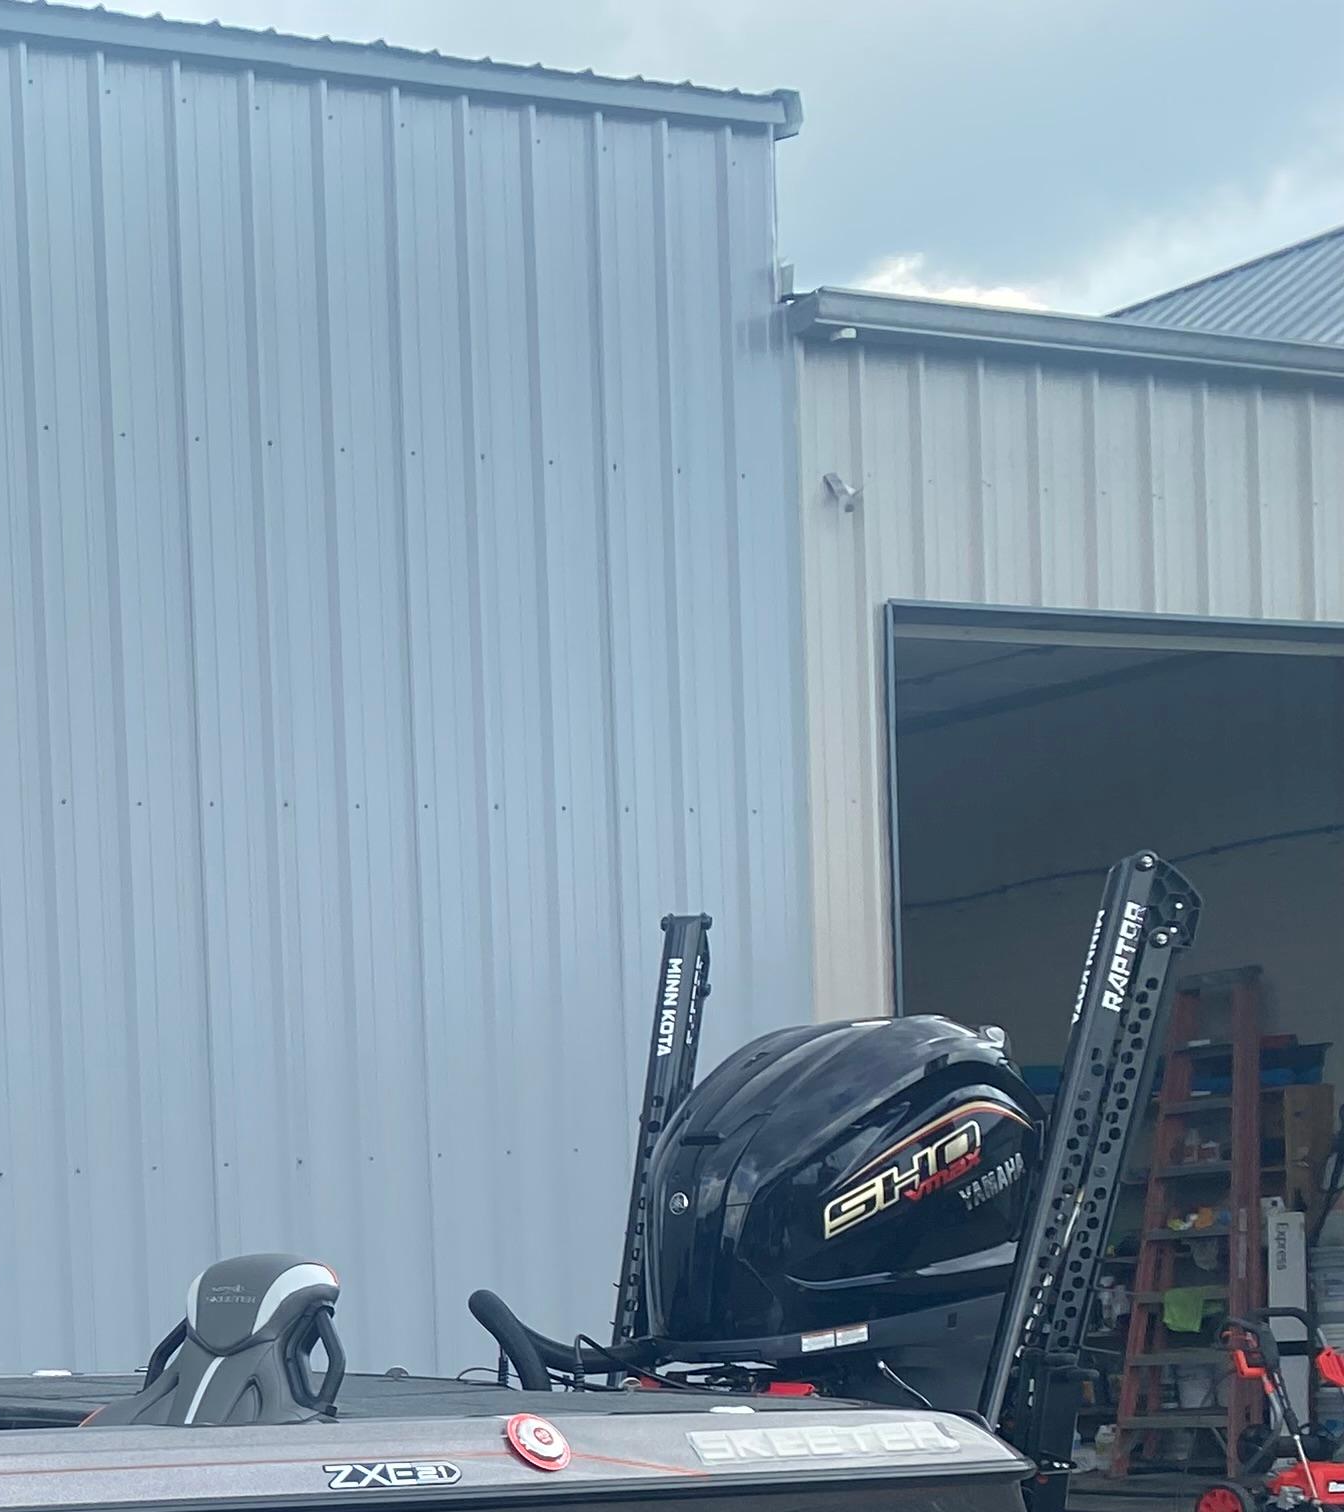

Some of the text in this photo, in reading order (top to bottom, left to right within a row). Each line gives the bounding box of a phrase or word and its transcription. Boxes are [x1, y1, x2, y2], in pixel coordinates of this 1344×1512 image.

[1101, 901, 1147, 1012] RAPTOR
[657, 958, 683, 1057] MINN KOTA
[824, 1120, 981, 1240] SHO
[959, 1152, 1026, 1211] YAMAHA
[696, 1421, 954, 1462] SKEETER
